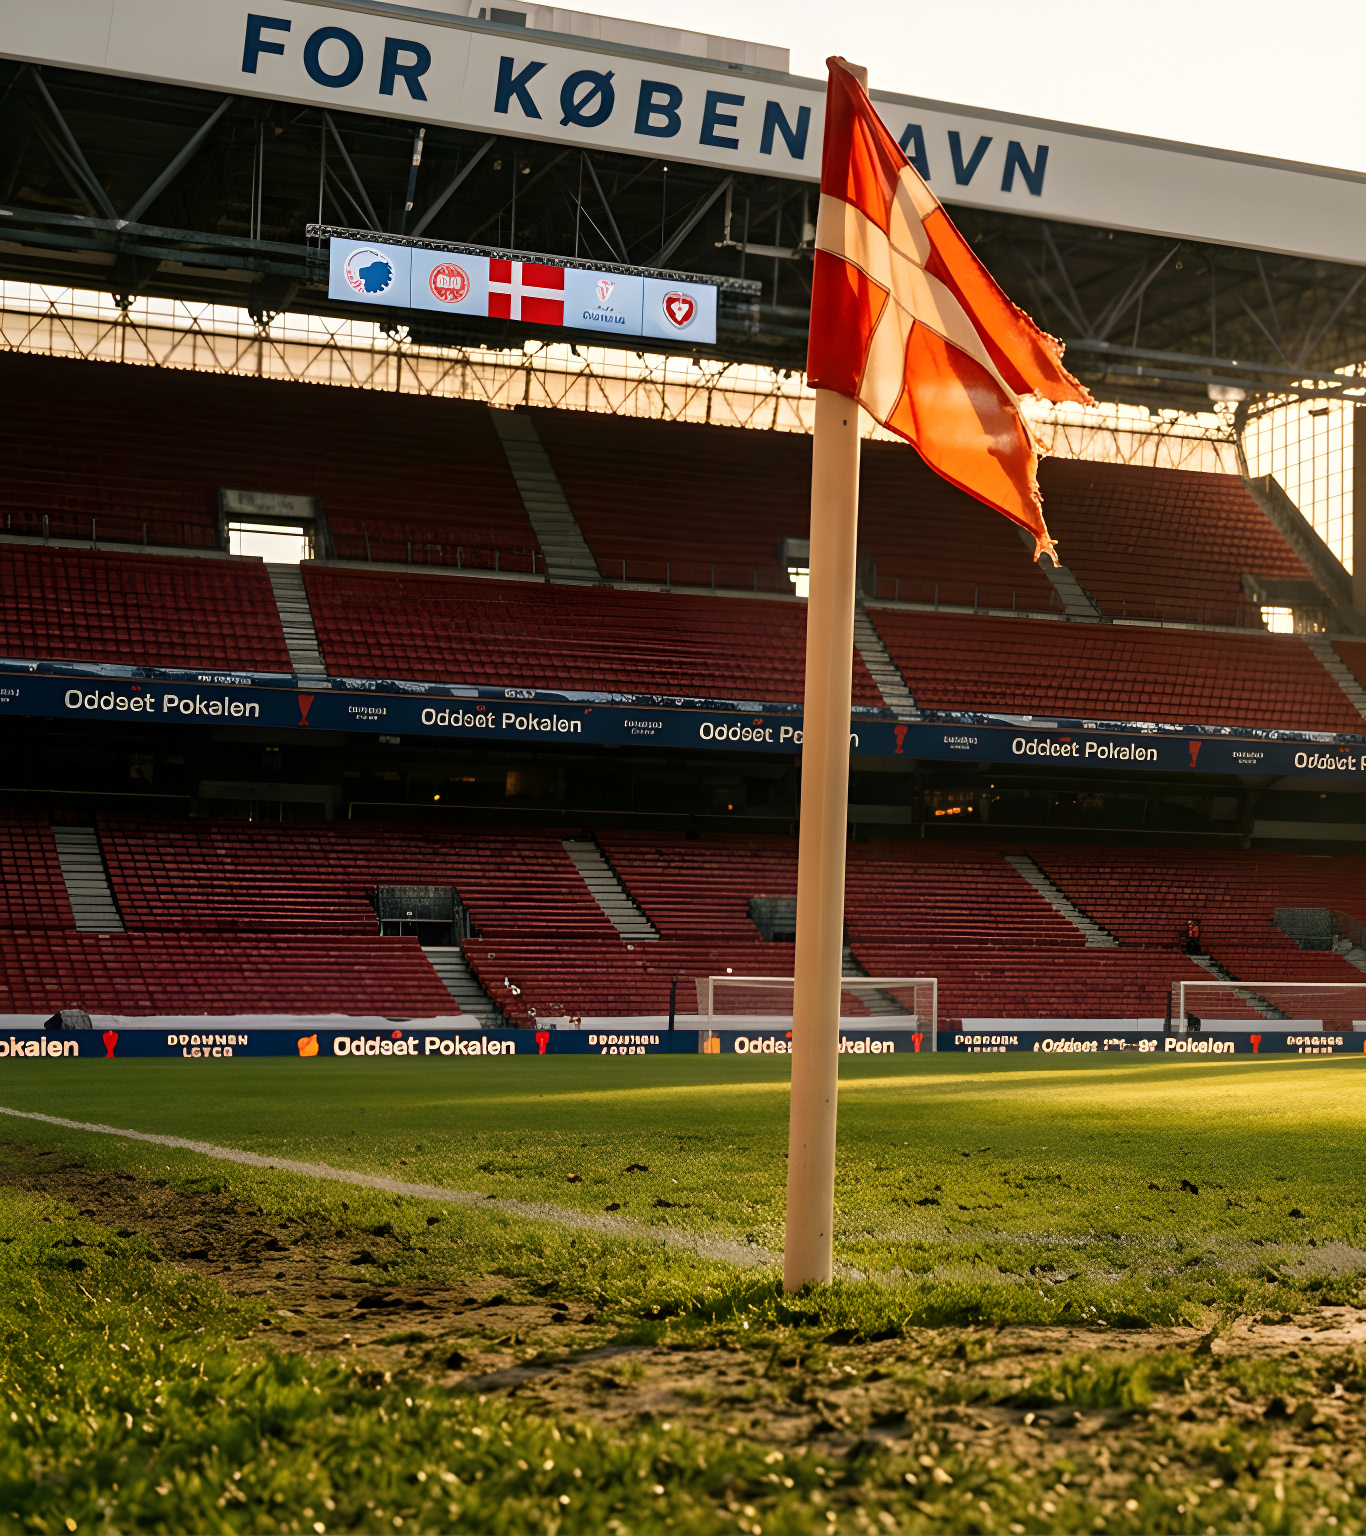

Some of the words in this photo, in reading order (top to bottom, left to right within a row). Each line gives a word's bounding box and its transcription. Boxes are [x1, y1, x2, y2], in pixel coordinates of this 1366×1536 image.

[241, 13, 429, 102] FOR
[493, 55, 1050, 197] KØBENAVN
[162, 694, 260, 718] Pokalen
[0, 1036, 79, 1057] okalen
